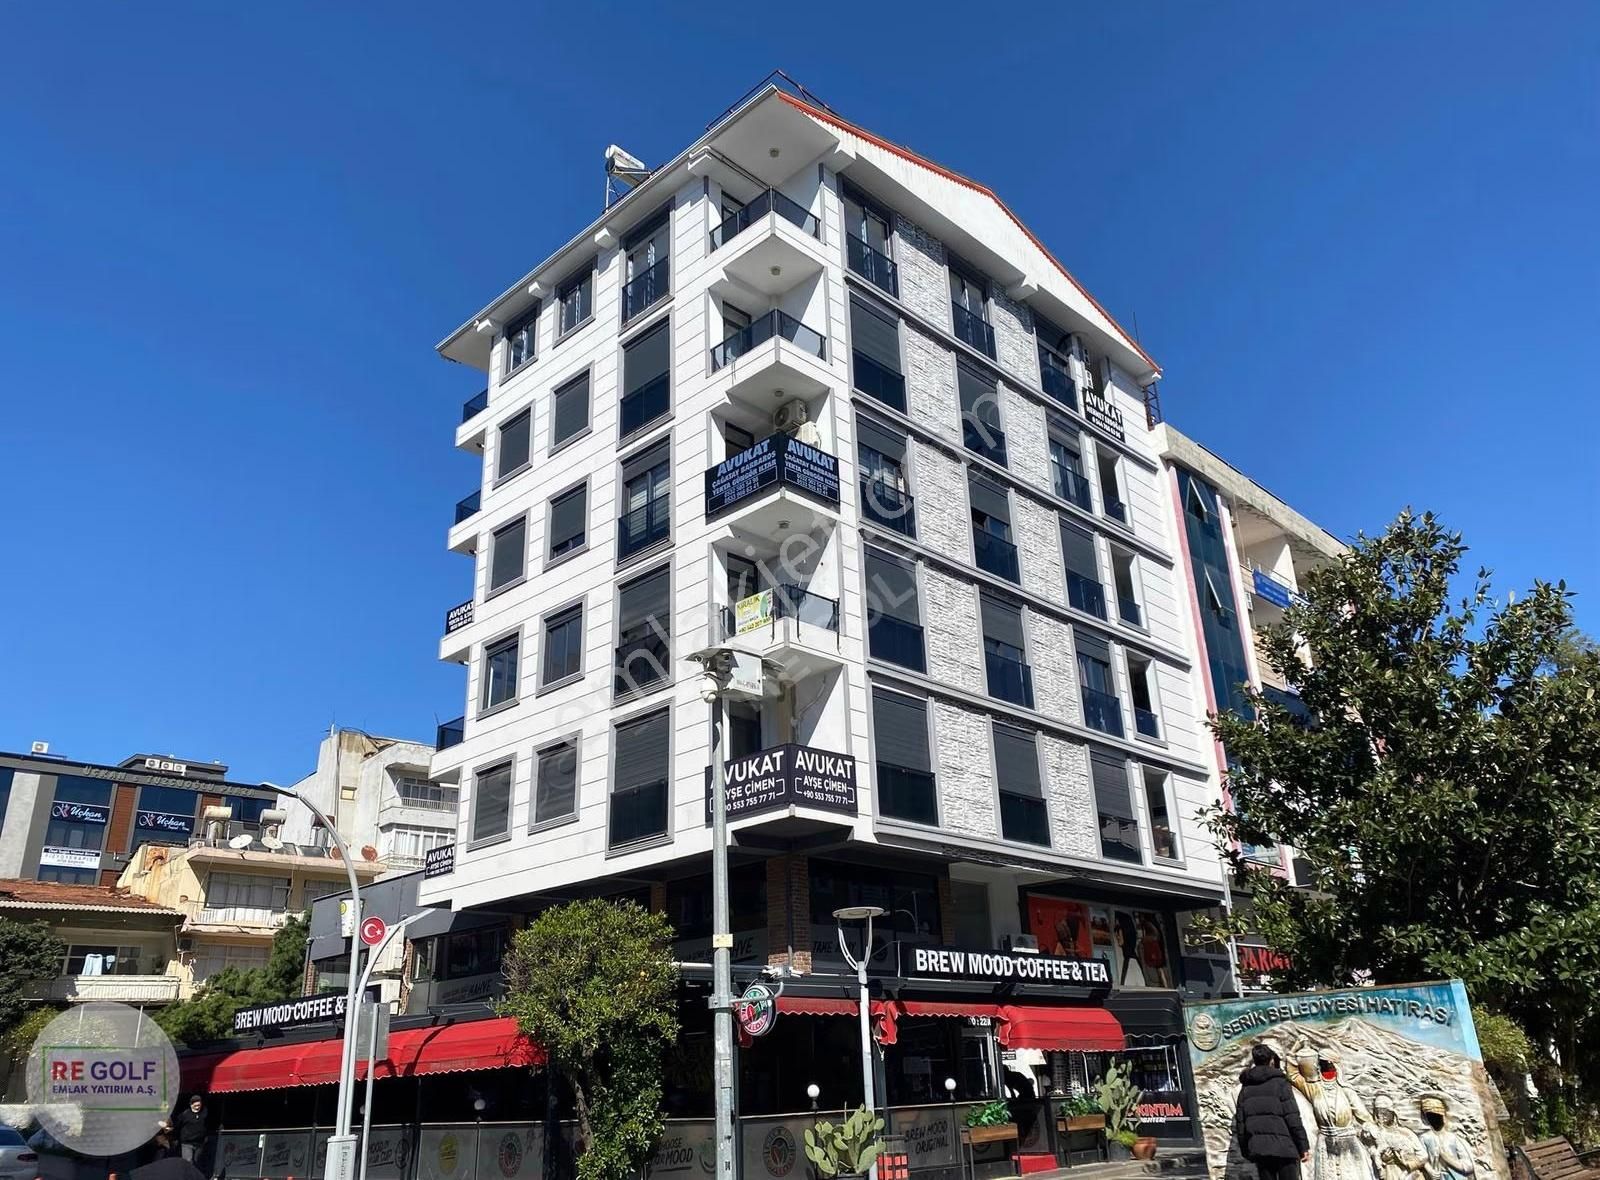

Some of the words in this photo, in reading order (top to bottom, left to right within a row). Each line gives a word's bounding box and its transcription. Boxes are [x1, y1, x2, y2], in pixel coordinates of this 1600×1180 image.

[1085, 390, 1122, 424] AVUKAT
[717, 438, 770, 477] AVUKAT
[787, 439, 835, 471] AVUKAT
[710, 751, 784, 789] VUKAT
[795, 750, 852, 779] AVUKAT
[725, 786, 743, 800] YŞE
[744, 777, 775, 796] ÇİMEN
[803, 775, 822, 789] AYŞE
[823, 777, 847, 793] ÇİMEN
[803, 790, 814, 799] +90
[814, 791, 824, 800] 553
[825, 793, 835, 802] 755
[835, 795, 842, 803] 77
[842, 796, 848, 804] 71
[733, 799, 745, 810] 553
[746, 797, 757, 807] 755
[758, 794, 767, 803] 77
[767, 791, 776, 801] 71
[915, 949, 965, 973] BREW
[967, 953, 1013, 977] MOOD
[1016, 958, 1070, 980] COFFEE
[1071, 961, 1083, 981] &
[1083, 962, 1109, 982] TEA
[235, 1011, 261, 1030] BREW
[262, 1004, 291, 1025] MOOD
[293, 997, 333, 1019] COFFEE
[335, 997, 344, 1014] &
[1222, 1009, 1267, 1039] SERİK
[1266, 993, 1363, 1023] BELEDİYESİ
[1366, 997, 1453, 1027] HATIRASI
